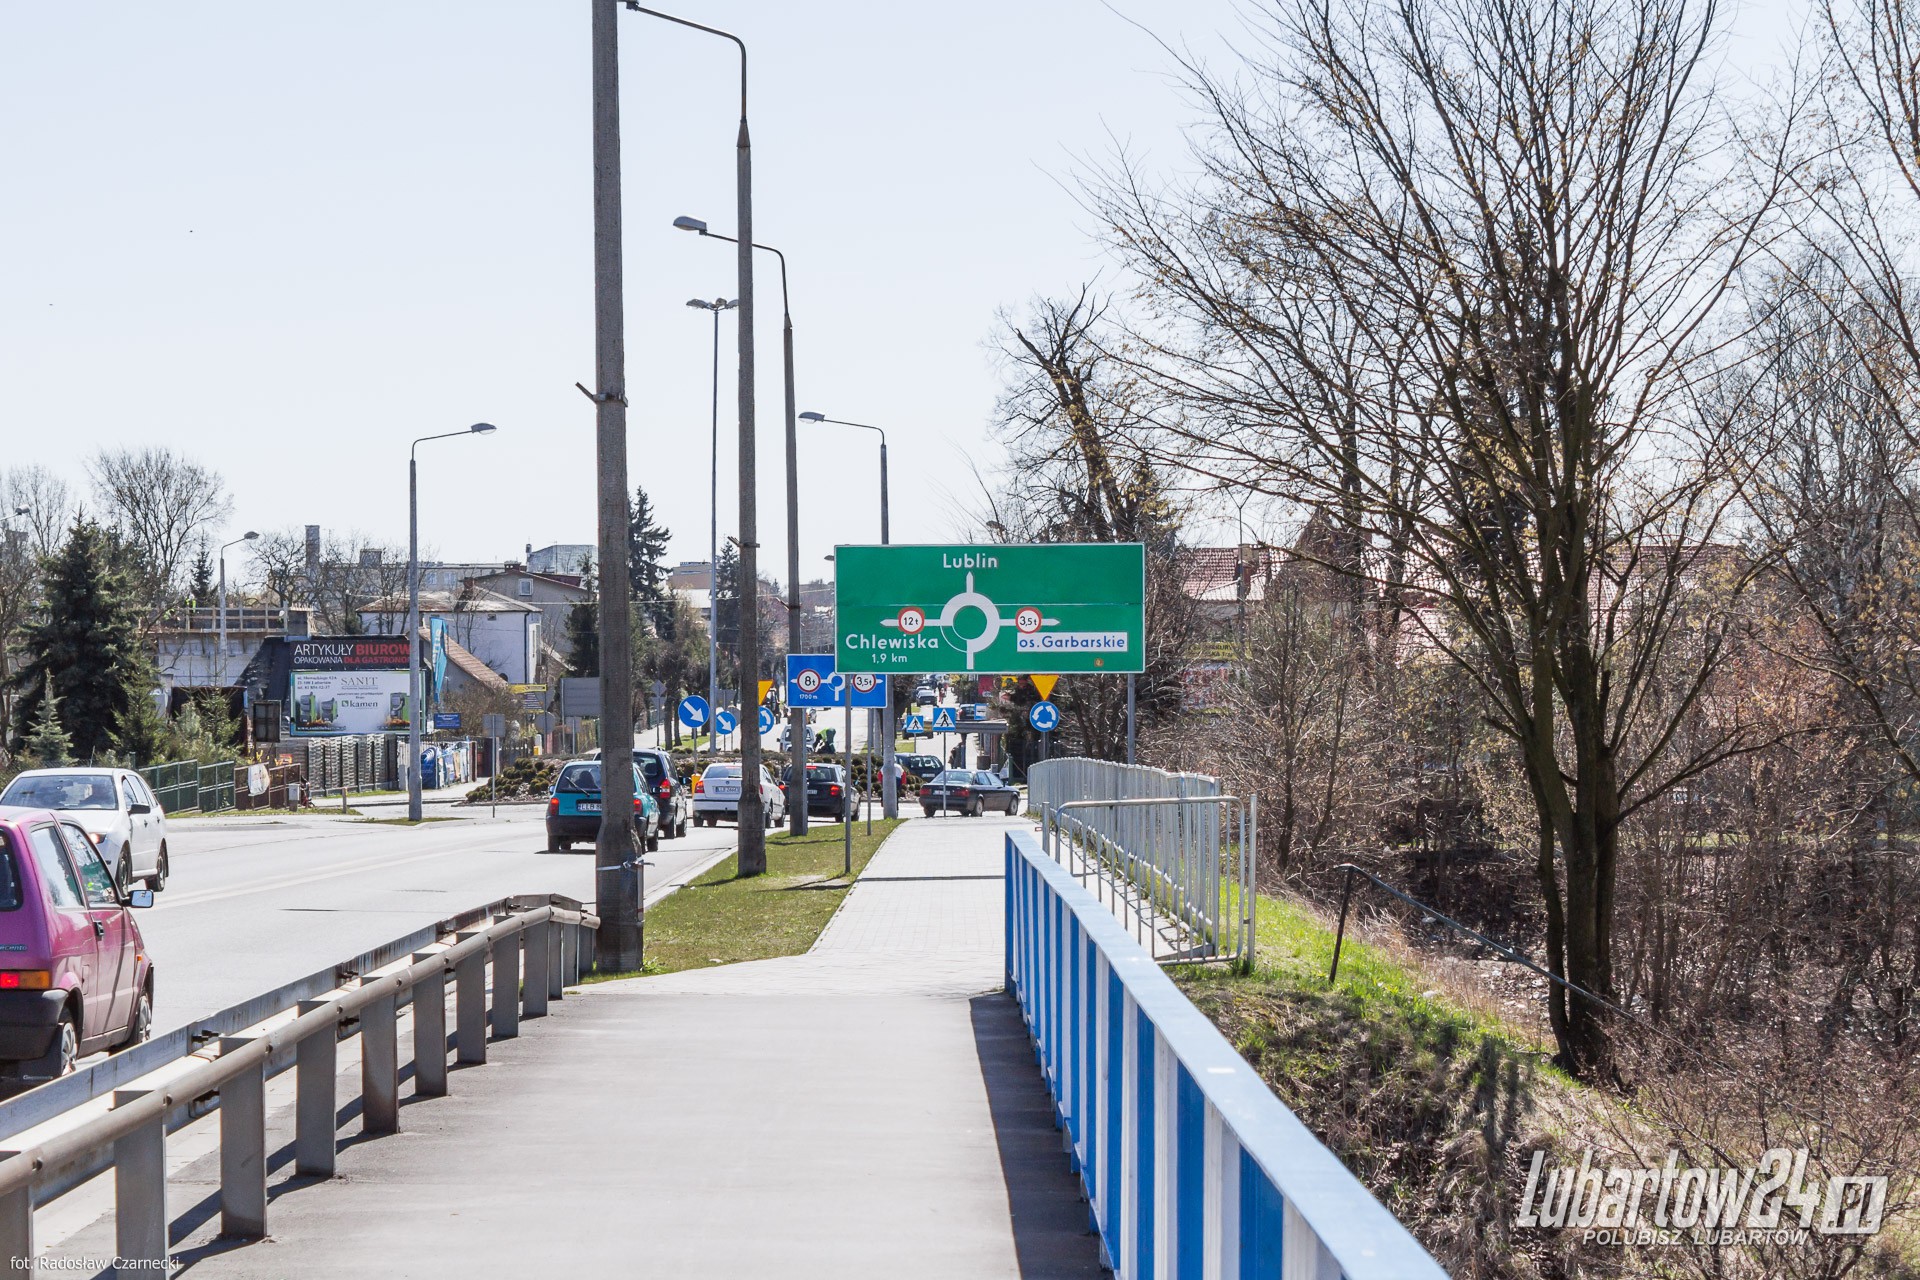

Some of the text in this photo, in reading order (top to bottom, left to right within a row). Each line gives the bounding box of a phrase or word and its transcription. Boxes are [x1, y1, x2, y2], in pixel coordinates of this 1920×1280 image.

[943, 553, 998, 569] Lublin
[845, 633, 940, 650] Chlewiska
[294, 643, 411, 656] ARTYKUŁY BIUROW
[293, 656, 411, 665] OPAKOWANIA DLA GASTRONO
[871, 653, 908, 665] 1,9 km
